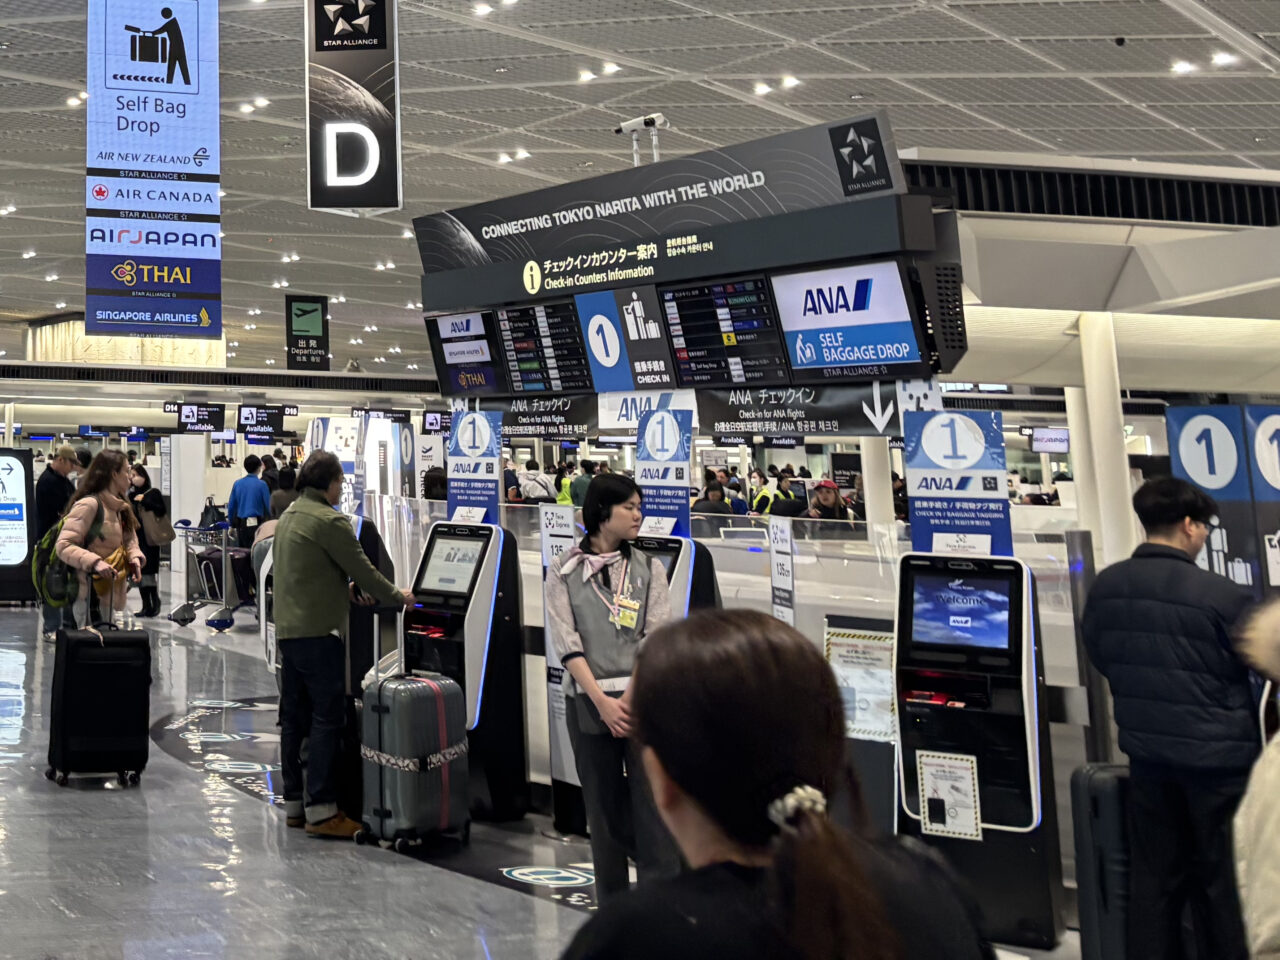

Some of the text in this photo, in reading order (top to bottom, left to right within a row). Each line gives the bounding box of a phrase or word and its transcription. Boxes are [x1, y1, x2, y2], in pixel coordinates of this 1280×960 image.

[343, 38, 379, 46] ALLIANCE
[116, 95, 187, 119] Self Bag
[117, 115, 161, 137] Drop
[96, 151, 191, 165] AIR NEW ZEALAND
[324, 122, 380, 186] D
[120, 170, 178, 180] STAR ALLIANCE
[115, 188, 214, 204] AIR CANADA
[481, 170, 765, 240] CONNECTING TOKYO NARITA WITH THE WORLD
[120, 210, 179, 221] STAR ALLIANCE
[543, 242, 658, 274] チェックインカウンター案内
[138, 264, 191, 284] THAI
[544, 265, 655, 290] Check-in Counters Information
[803, 285, 851, 317] ANA
[95, 310, 198, 323] SINGAPORE AIRLINES
[450, 320, 465, 334] ANA
[595, 323, 611, 358] 1
[819, 332, 844, 347] SELF
[291, 347, 325, 355] Departures
[822, 342, 911, 363] BAGGAGE DROP
[637, 373, 671, 384] CHECK IN
[824, 366, 880, 377] STAR ALLIANCE
[466, 373, 486, 386] THAI
[728, 387, 815, 406] ANA チェックイン
[510, 397, 571, 412] ANA チェックイン
[541, 415, 552, 423] ANA
[739, 409, 806, 420] Check-in for ANA flights
[186, 423, 216, 431] Available.
[246, 425, 275, 433] Available.
[782, 422, 795, 431] ANA
[796, 420, 816, 432] 항공편
[818, 419, 839, 432] 체크인
[467, 417, 480, 450] 1
[656, 416, 671, 453] 1
[941, 418, 967, 460] 1
[1195, 428, 1217, 476] 1
[452, 462, 472, 473] ANA
[640, 468, 661, 479] ANA
[917, 477, 953, 490] ANA
[936, 594, 985, 606] Welcome
